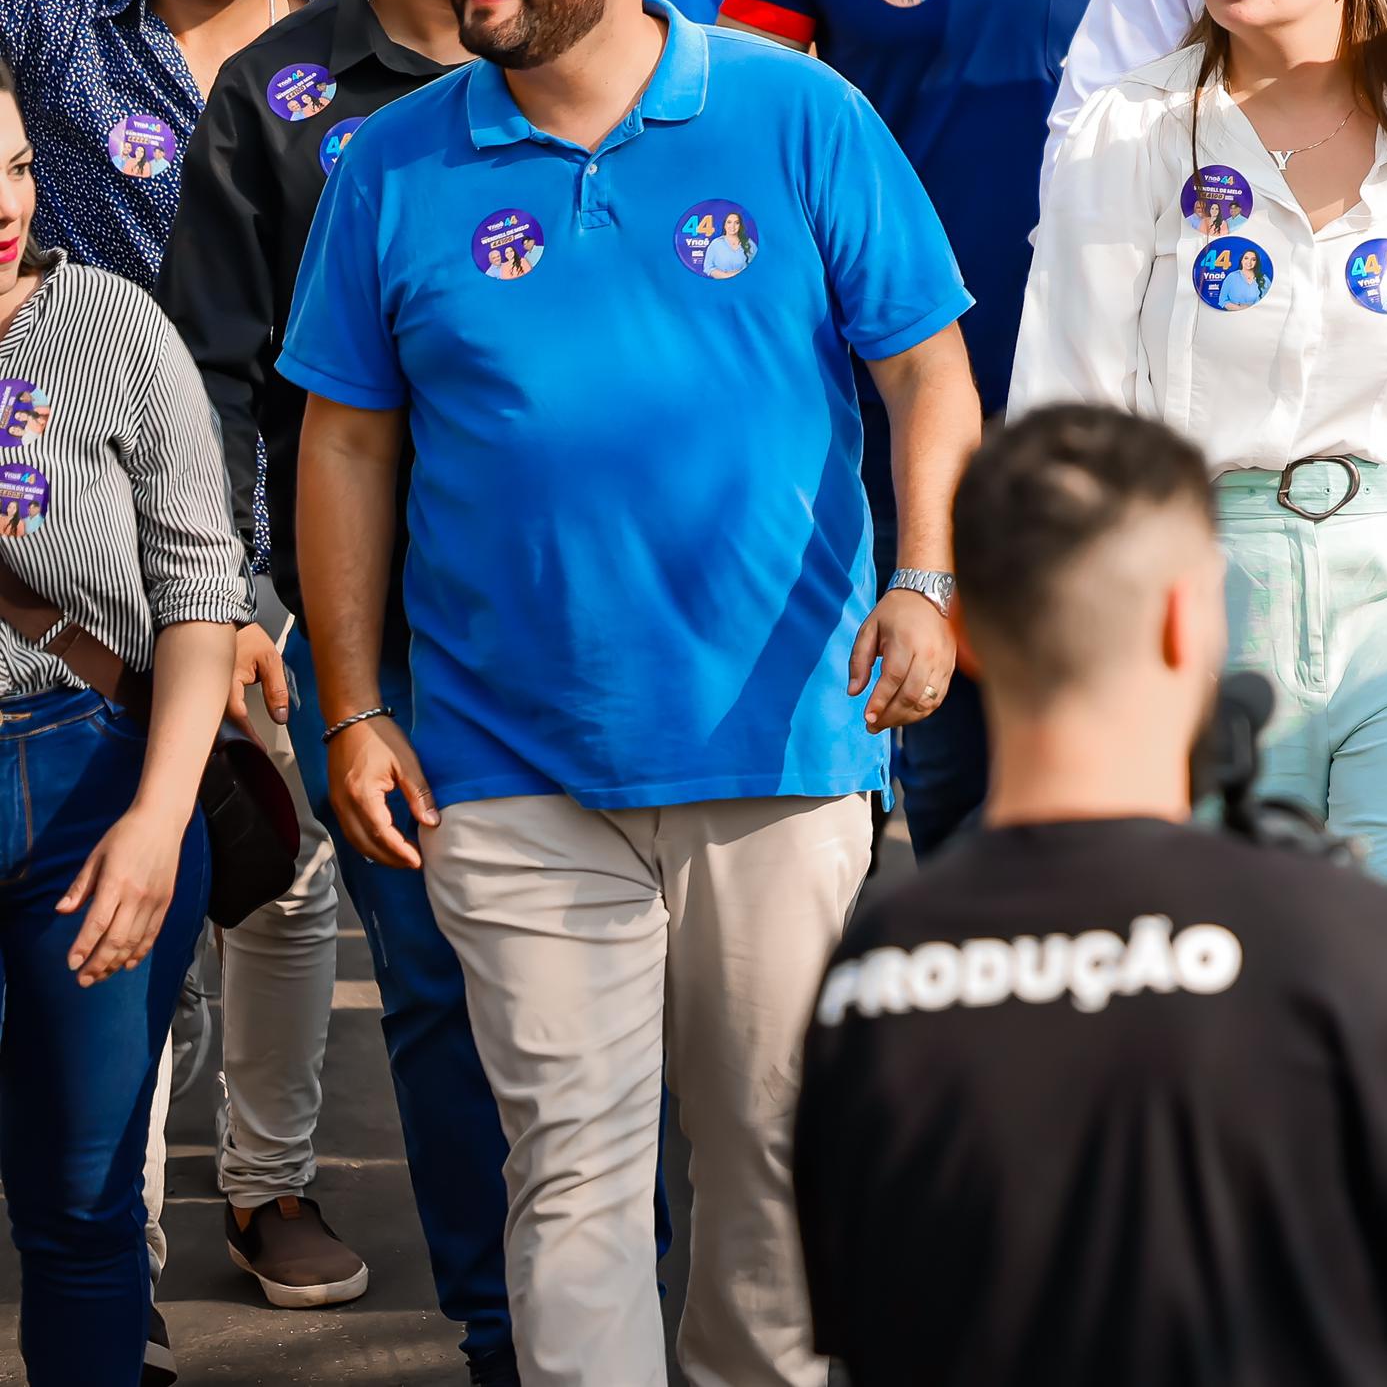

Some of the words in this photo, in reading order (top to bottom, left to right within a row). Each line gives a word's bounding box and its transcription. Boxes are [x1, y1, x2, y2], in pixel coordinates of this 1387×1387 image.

[1270, 150, 1294, 170] Y
[682, 215, 715, 237] 44
[1201, 249, 1232, 271] 44
[1351, 254, 1382, 277] 44
[816, 914, 1243, 1027] PRODUÇÃO
